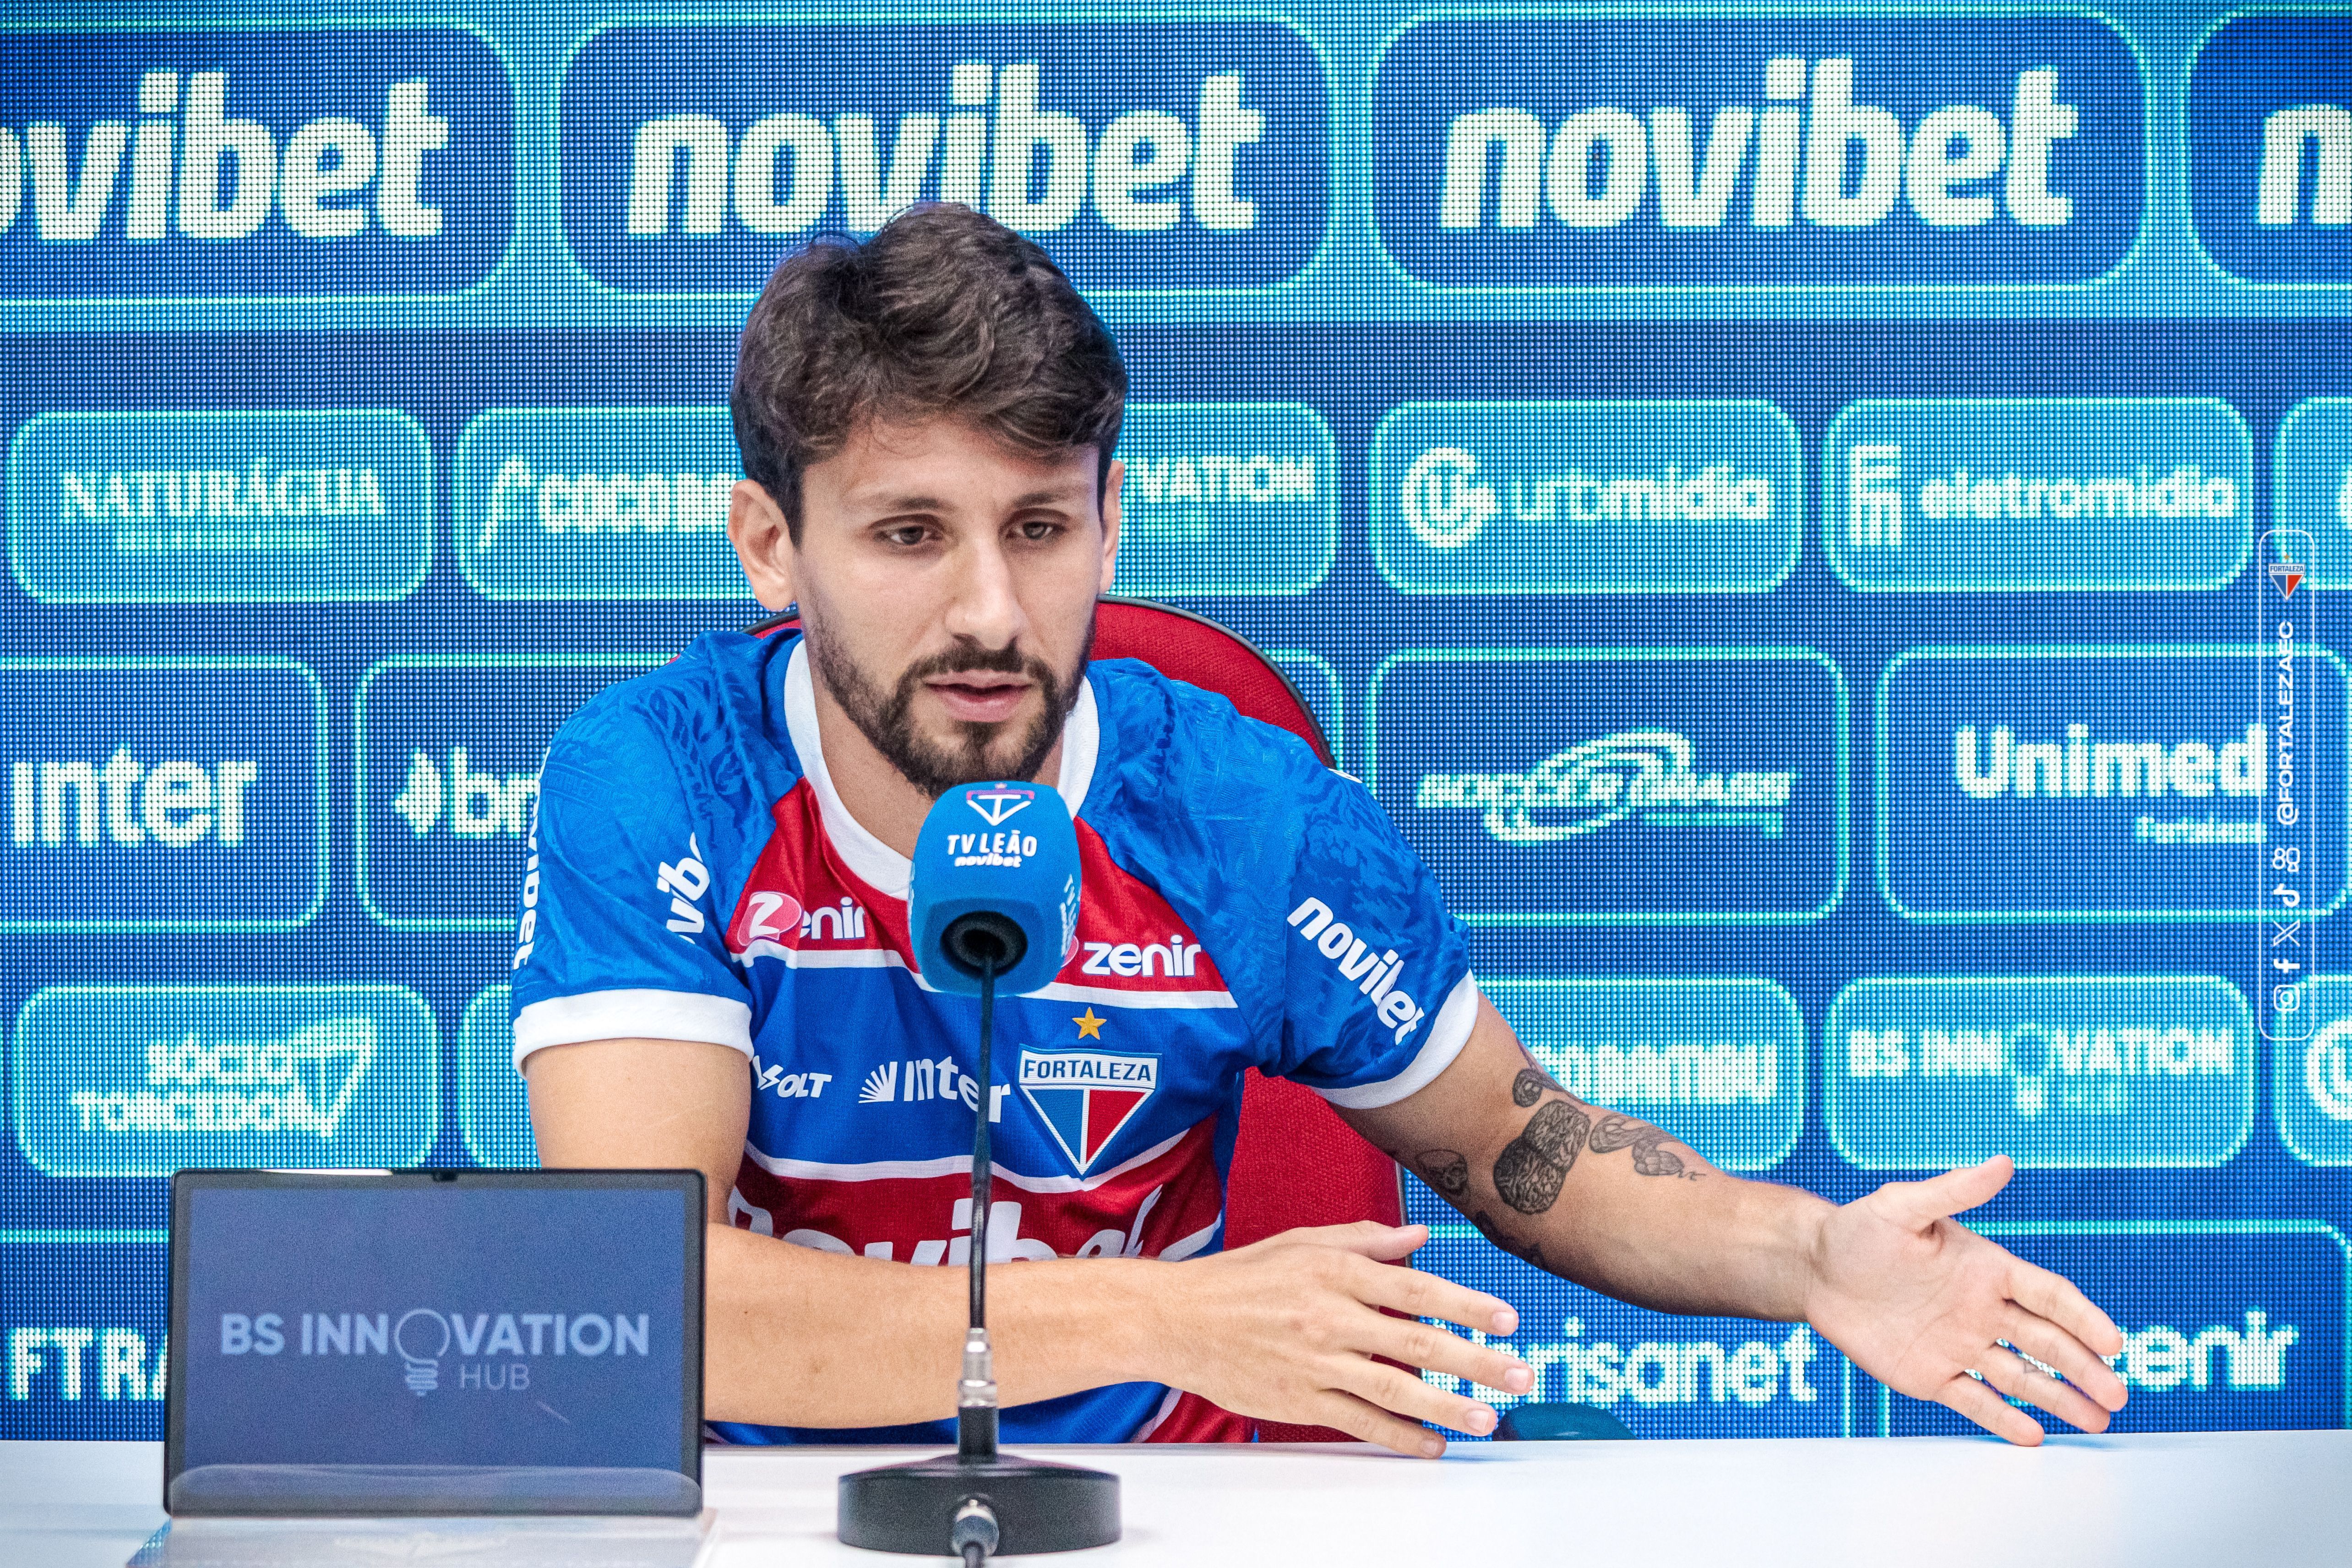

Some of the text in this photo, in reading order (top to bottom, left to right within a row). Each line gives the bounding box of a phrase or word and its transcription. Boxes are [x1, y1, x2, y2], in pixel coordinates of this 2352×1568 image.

[0, 69, 449, 241] vibet
[627, 63, 1266, 236] novibet
[1437, 55, 2078, 229] novibet
[62, 456, 386, 523] NATURÁGUA
[1132, 454, 1315, 504] VATION
[1955, 722, 2268, 799] Unimed
[947, 829, 1037, 857] TV LEÃO
[954, 852, 1023, 868] novibet
[1081, 934, 1201, 978] zenir
[147, 1033, 294, 1086] SÓCIO
[1024, 1058, 1152, 1083] FORTALEZA
[1530, 1042, 1778, 1105] OBAMBU
[1848, 1028, 1910, 1078] BS
[70, 1089, 316, 1132] TORCEDOR
[220, 1307, 650, 1357] BS INNOVATION
[460, 1364, 530, 1391] HUB
